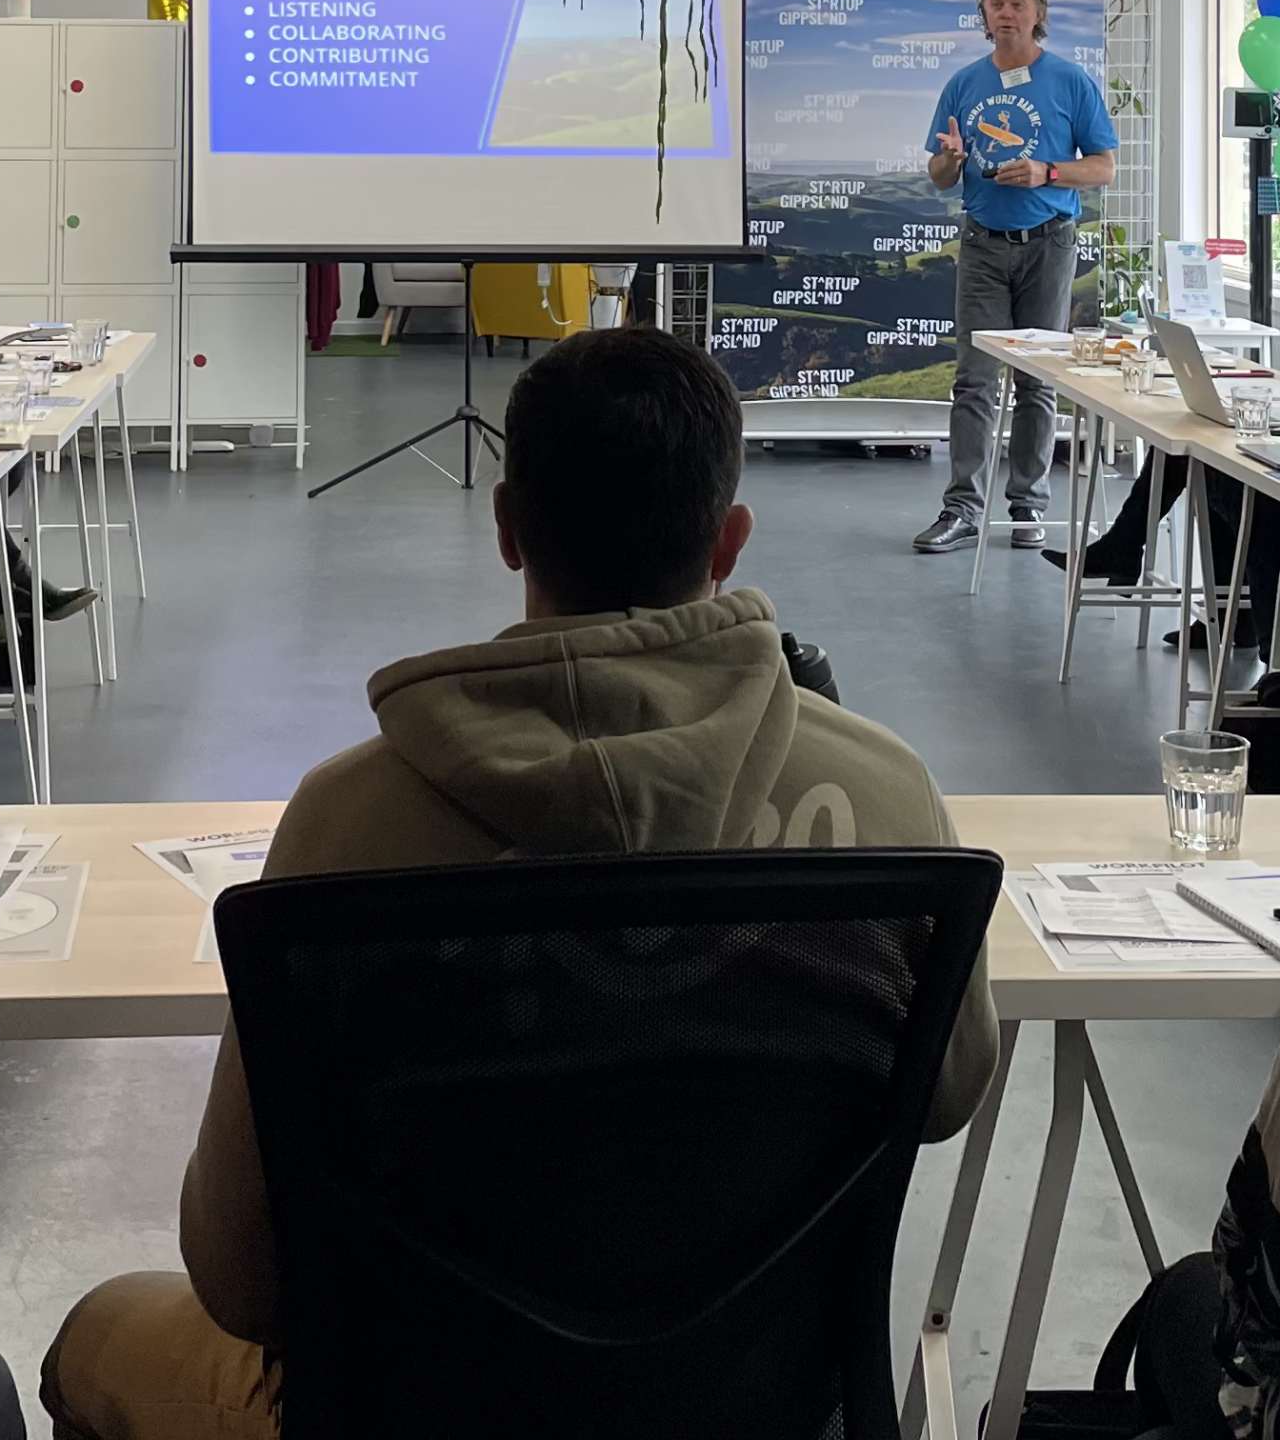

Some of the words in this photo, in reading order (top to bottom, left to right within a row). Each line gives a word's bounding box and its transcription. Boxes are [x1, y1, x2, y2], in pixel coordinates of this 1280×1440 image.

[268, 1, 377, 18] LISTENING
[268, 24, 447, 41] COLLABORATING
[269, 47, 430, 64] CONTRIBUTING
[269, 71, 420, 88] COMMITMENT
